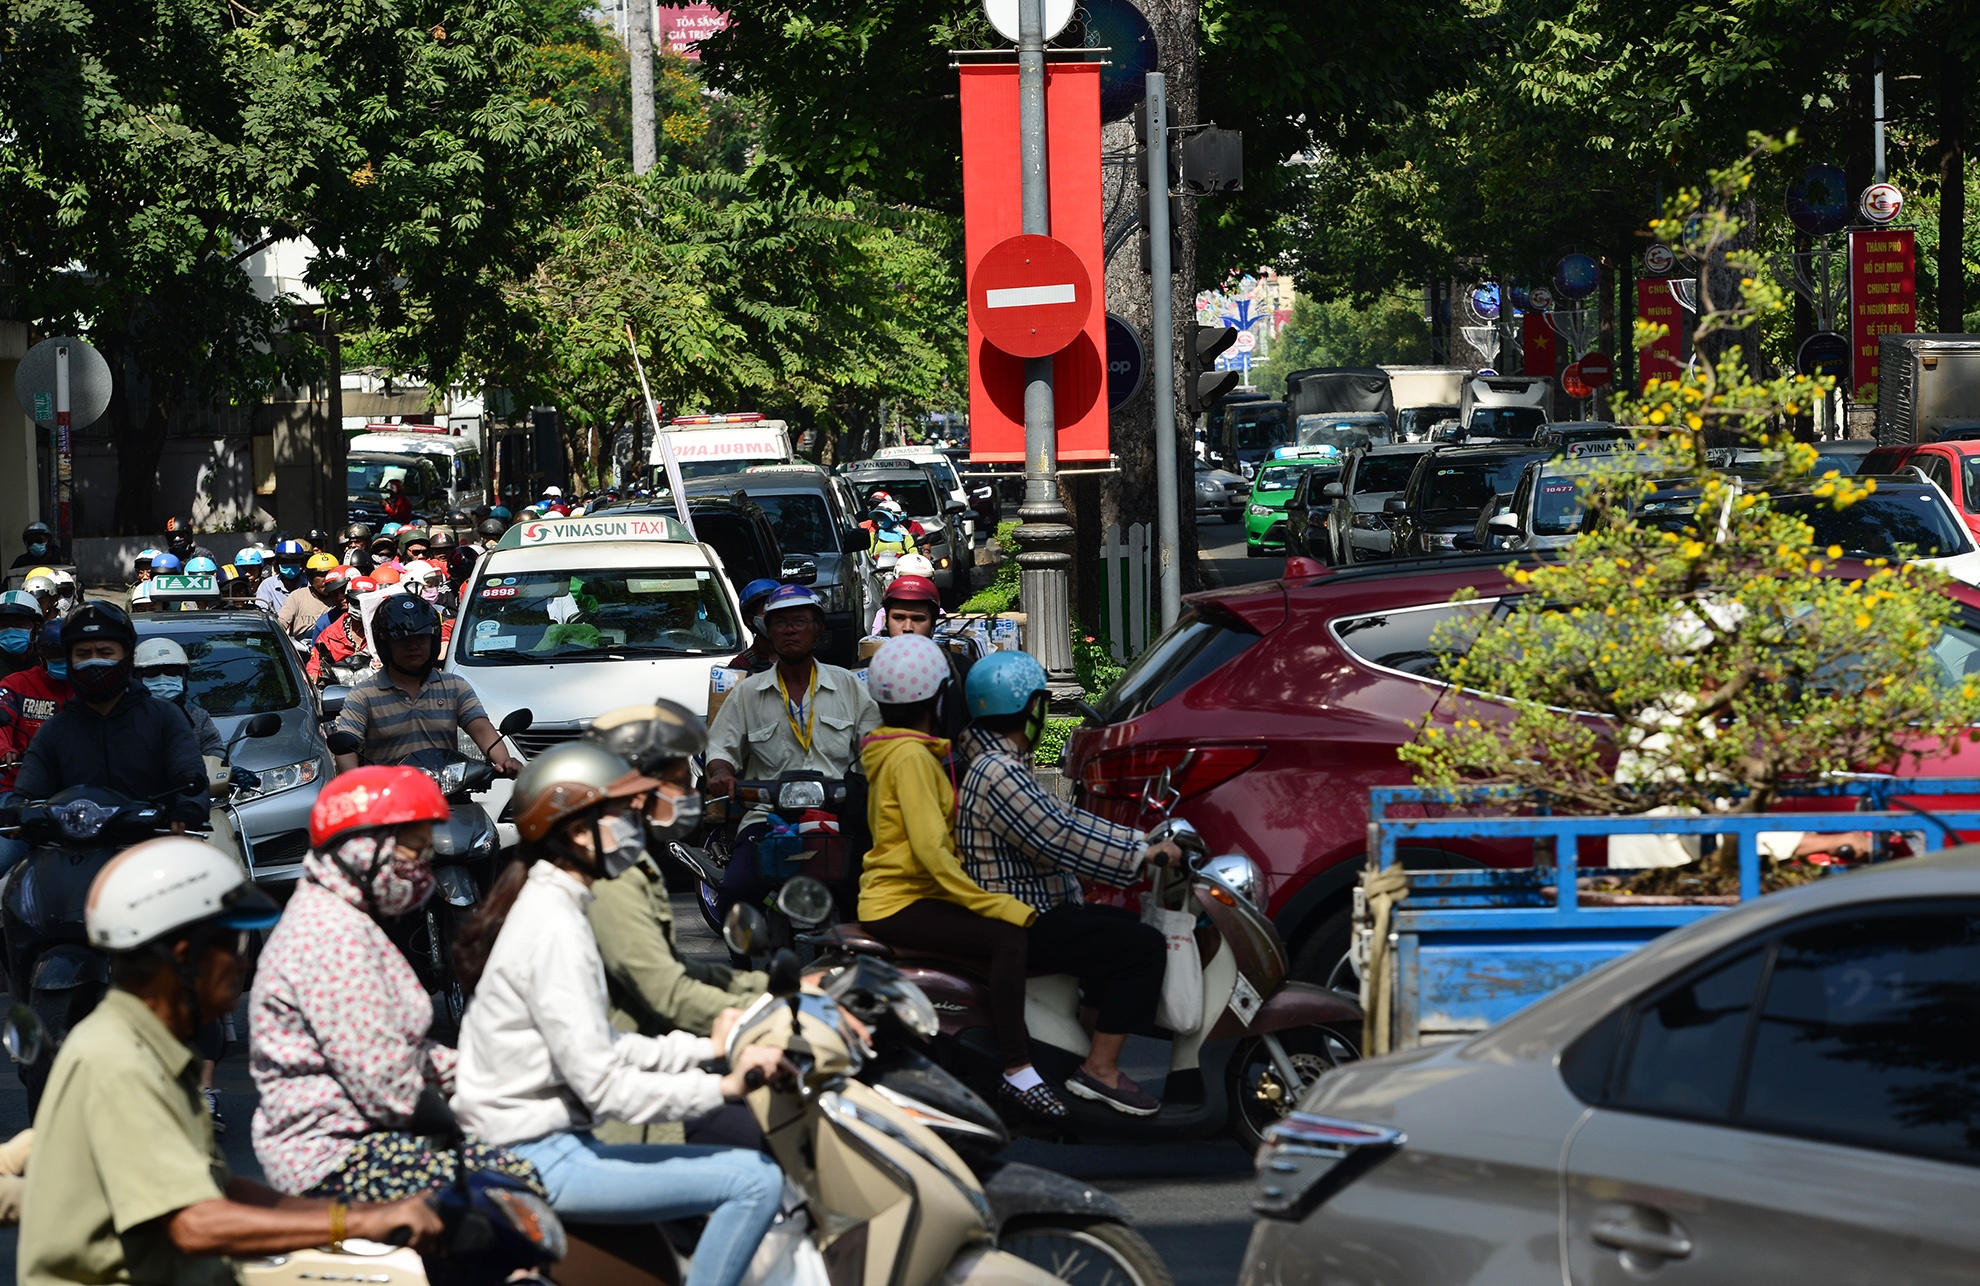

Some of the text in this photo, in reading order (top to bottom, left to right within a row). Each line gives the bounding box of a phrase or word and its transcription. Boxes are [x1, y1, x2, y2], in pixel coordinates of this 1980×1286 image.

[668, 28, 687, 40] GIÁ
[1866, 238, 1902, 253] THÀNH PHỐ
[1864, 260, 1904, 274] HỒ CHÍ MINH
[1867, 282, 1901, 294] CHUNG TAY
[1859, 302, 1866, 315] VÌ
[1888, 302, 1910, 314] NGHÈO
[862, 461, 894, 469] VINASUN
[554, 521, 664, 538] VINASUN TAXI
[482, 587, 516, 598] 6898
[23, 698, 56, 716] FRANCE
